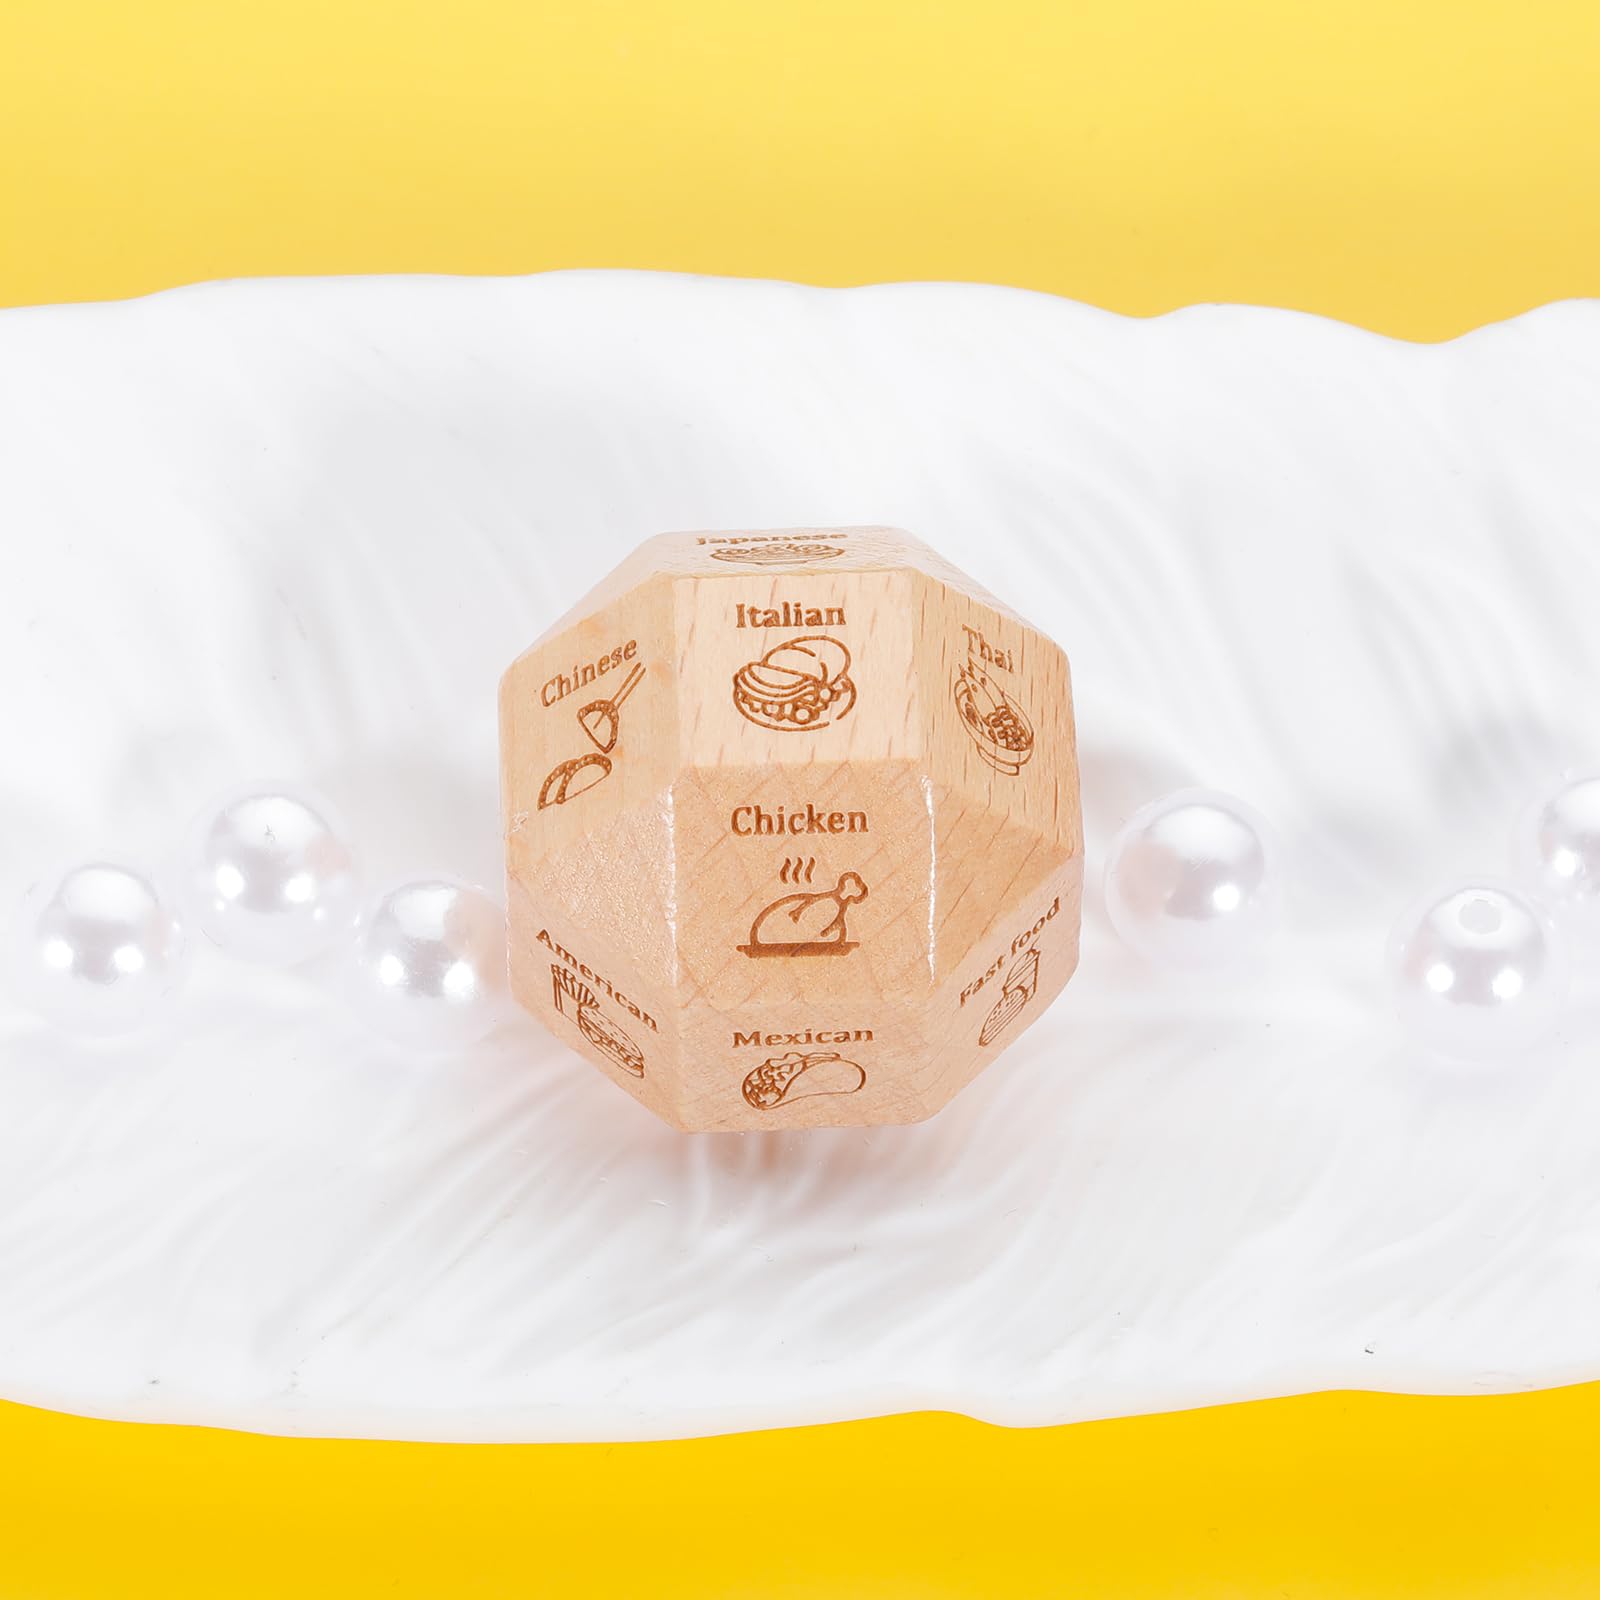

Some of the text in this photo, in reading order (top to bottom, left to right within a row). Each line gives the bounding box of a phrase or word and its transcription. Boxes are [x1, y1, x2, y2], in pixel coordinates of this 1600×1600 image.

[736, 601, 846, 628] Italian
[962, 623, 1013, 673] Thai
[540, 639, 637, 708] Chinese
[731, 803, 869, 836] Chicken
[960, 896, 1060, 1008] Fast food
[536, 929, 659, 1034] American
[732, 1028, 874, 1048] Mexican
